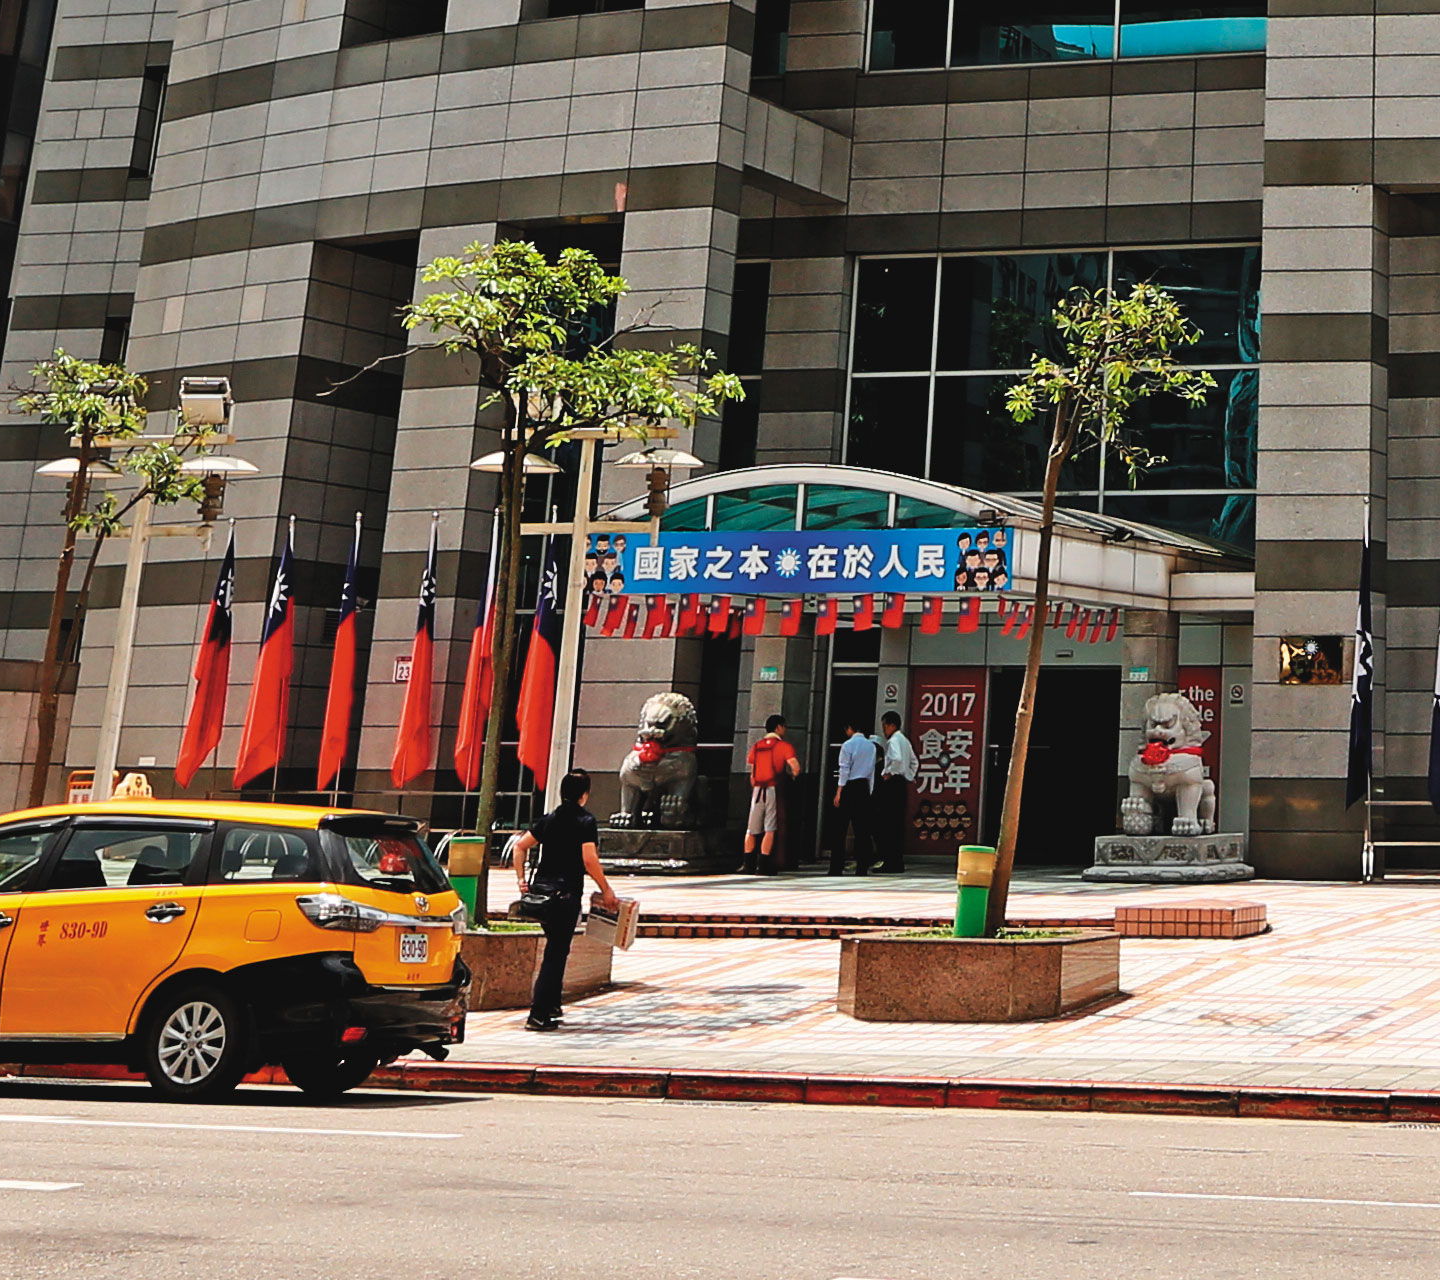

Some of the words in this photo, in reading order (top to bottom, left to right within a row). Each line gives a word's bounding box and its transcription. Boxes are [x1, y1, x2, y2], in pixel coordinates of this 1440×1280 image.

[634, 545, 771, 581] 國家之本
[806, 543, 946, 580] 在於人民
[920, 692, 976, 717] 2017
[1188, 685, 1215, 702] the
[919, 728, 973, 761] 食安
[916, 762, 971, 795] 元年
[59, 920, 109, 940] 830-9D
